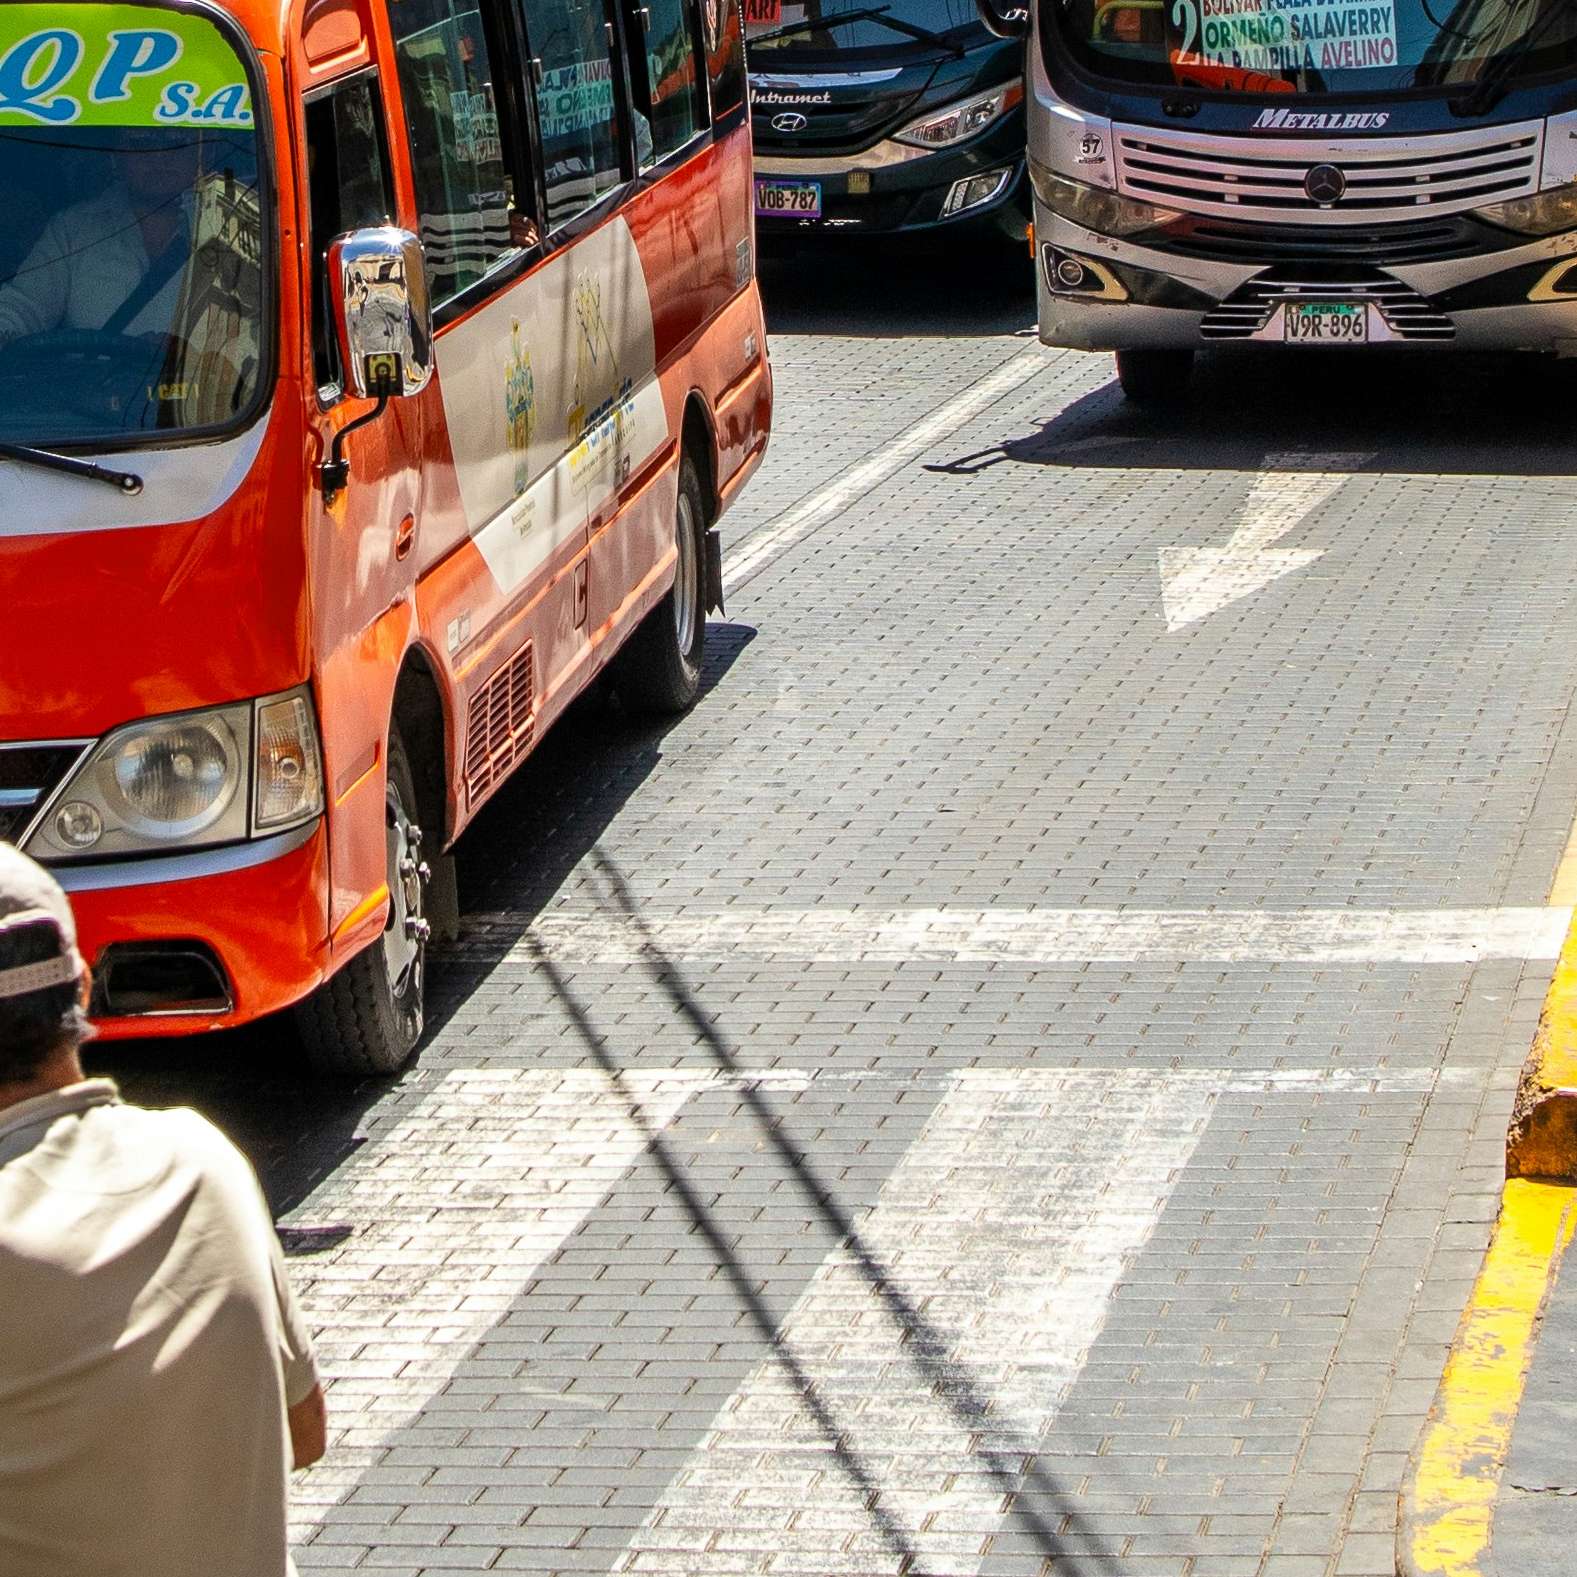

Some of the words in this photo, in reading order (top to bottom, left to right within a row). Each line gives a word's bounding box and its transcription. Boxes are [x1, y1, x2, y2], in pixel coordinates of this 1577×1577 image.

[1205, 13, 1285, 49] ORMEÑO
[1290, 6, 1392, 40] SALAVERRY
[1232, 42, 1315, 69] PAMPILLA
[1322, 37, 1394, 68] AVELINO
[158, 83, 251, 121] S.A.
[751, 90, 831, 104] Intramet
[1252, 108, 1389, 129] METALBUS
[1082, 139, 1100, 154] 57
[1311, 305, 1341, 314] PERU
[1289, 313, 1363, 338] V9R-896
